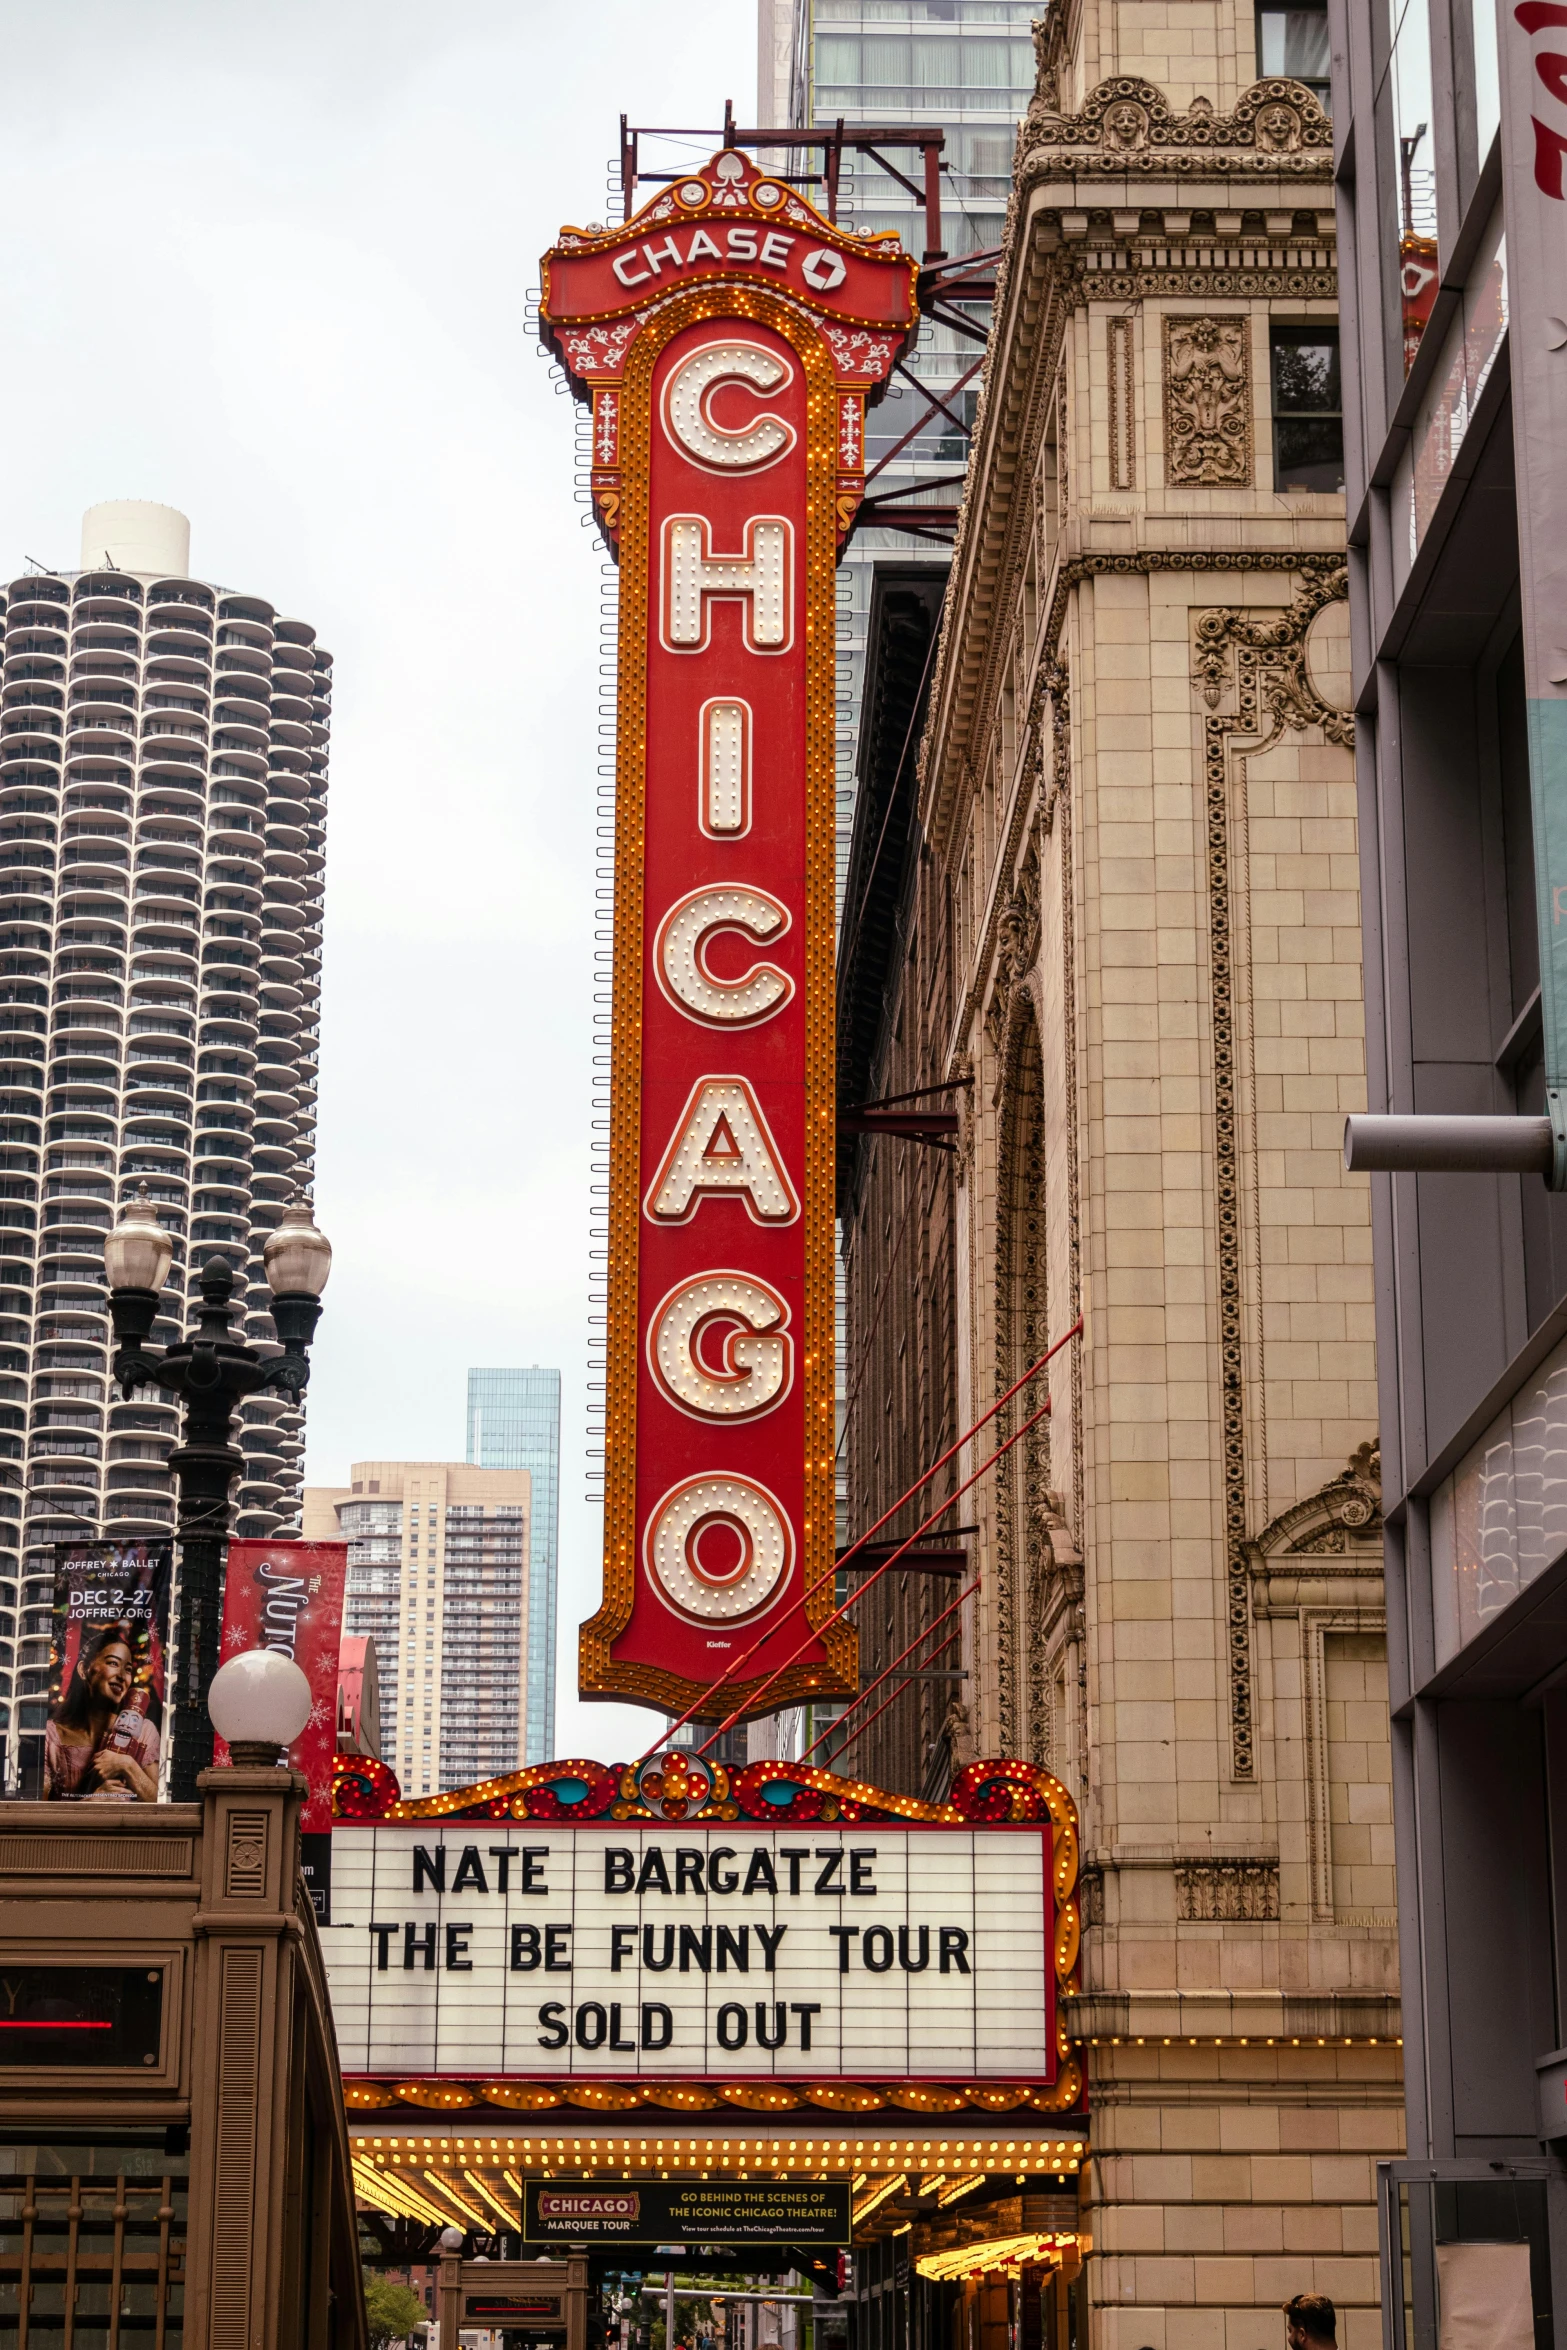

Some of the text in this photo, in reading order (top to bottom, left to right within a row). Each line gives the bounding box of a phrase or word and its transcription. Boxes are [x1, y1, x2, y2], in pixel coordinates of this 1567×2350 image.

[612, 228, 795, 287] CHASE
[643, 338, 798, 1631] CHICAGO
[62, 1559, 160, 1570] JOFFREY BALLET
[308, 1574, 322, 1594] THE
[70, 1590, 107, 1606] DEC
[69, 1607, 152, 1619] JOFFREY.ORG
[706, 1640, 732, 1648] Kieffer
[412, 1844, 877, 1897] NATE BARGATZE
[369, 1921, 972, 1975] THE BE FUNNY TOUR
[537, 2001, 822, 2052] SOLD OUT
[681, 2193, 826, 2203] GO BEHIND THE SCENES OF
[549, 2199, 629, 2212] CHICAGO
[669, 2207, 837, 2218] THE ICONIC CHICAGO THEATRE!
[547, 2220, 630, 2232] MARQUEE TOUR
[743, 2225, 825, 2234] TheChicagoTheatre.com/tour
